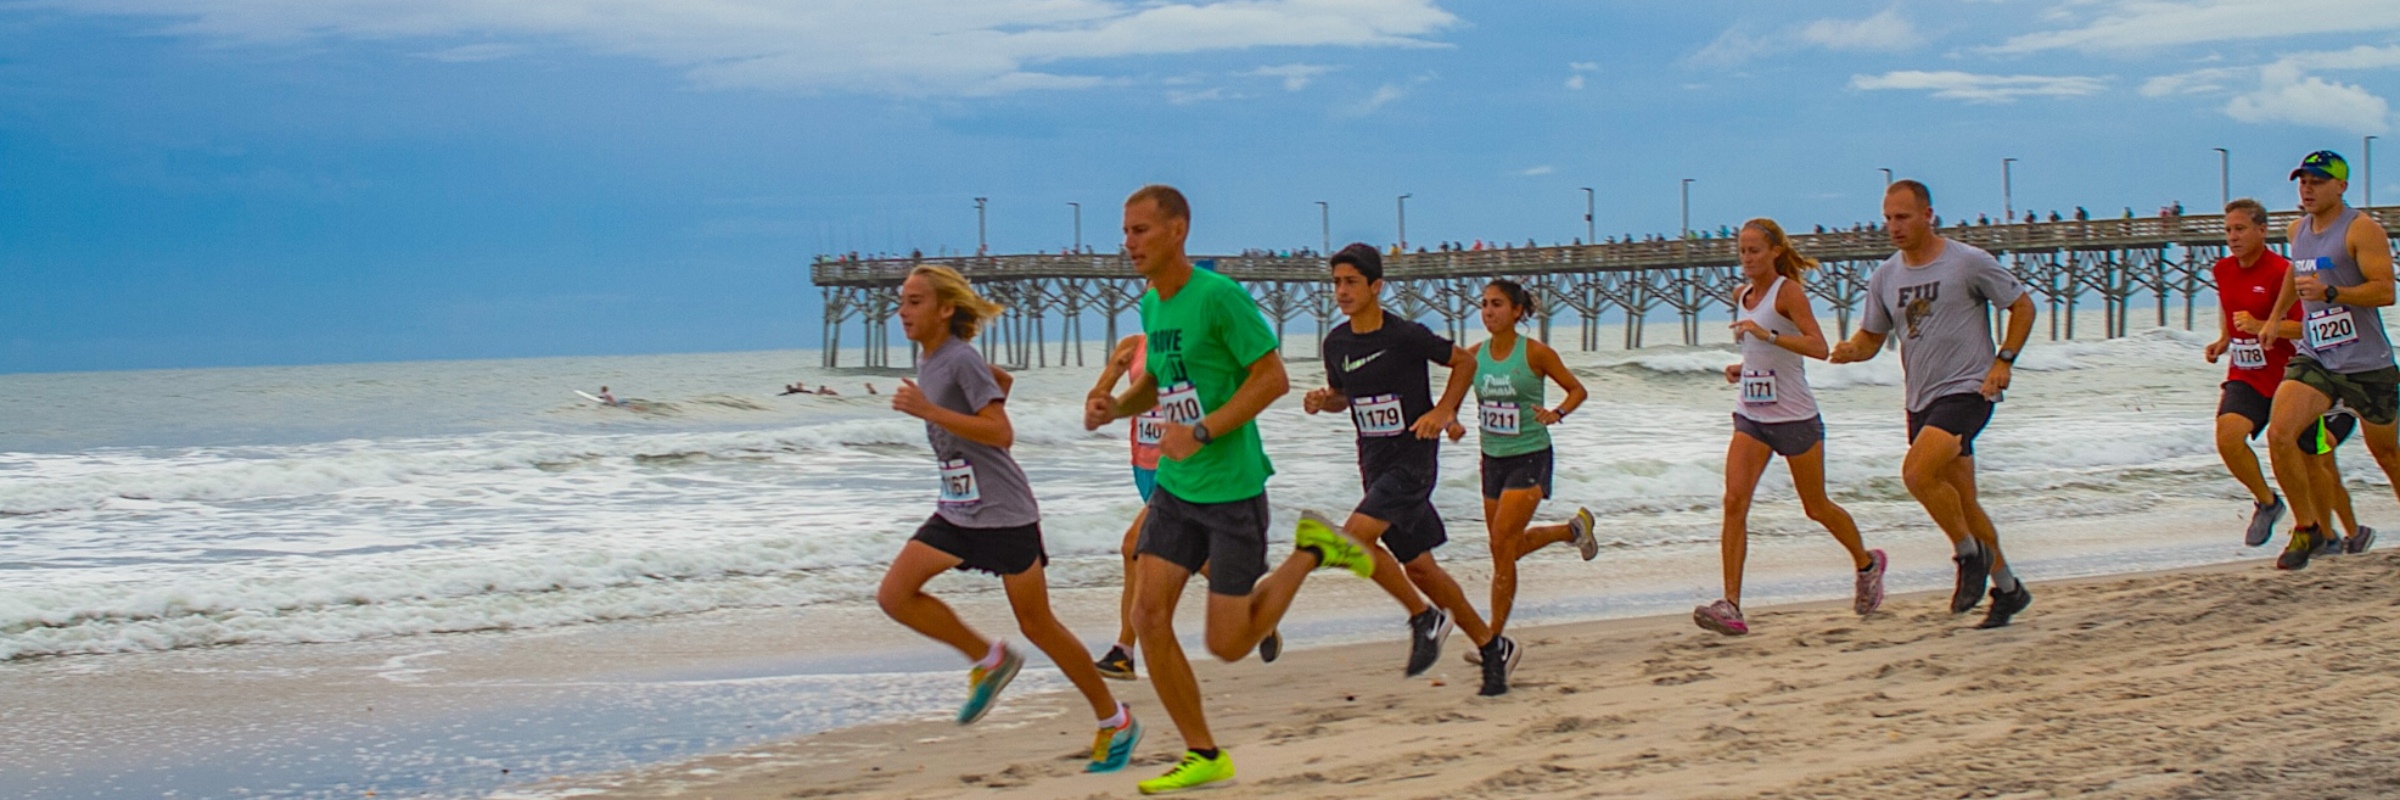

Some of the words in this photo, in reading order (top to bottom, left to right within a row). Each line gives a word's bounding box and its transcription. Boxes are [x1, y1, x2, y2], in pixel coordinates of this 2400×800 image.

[1897, 280, 1941, 308] FIU
[2311, 318, 2352, 342] 1220
[2232, 348, 2263, 363] 1178
[1744, 380, 1772, 398] 1171
[1357, 407, 1400, 428] 1179
[1482, 409, 1515, 430] 1211
